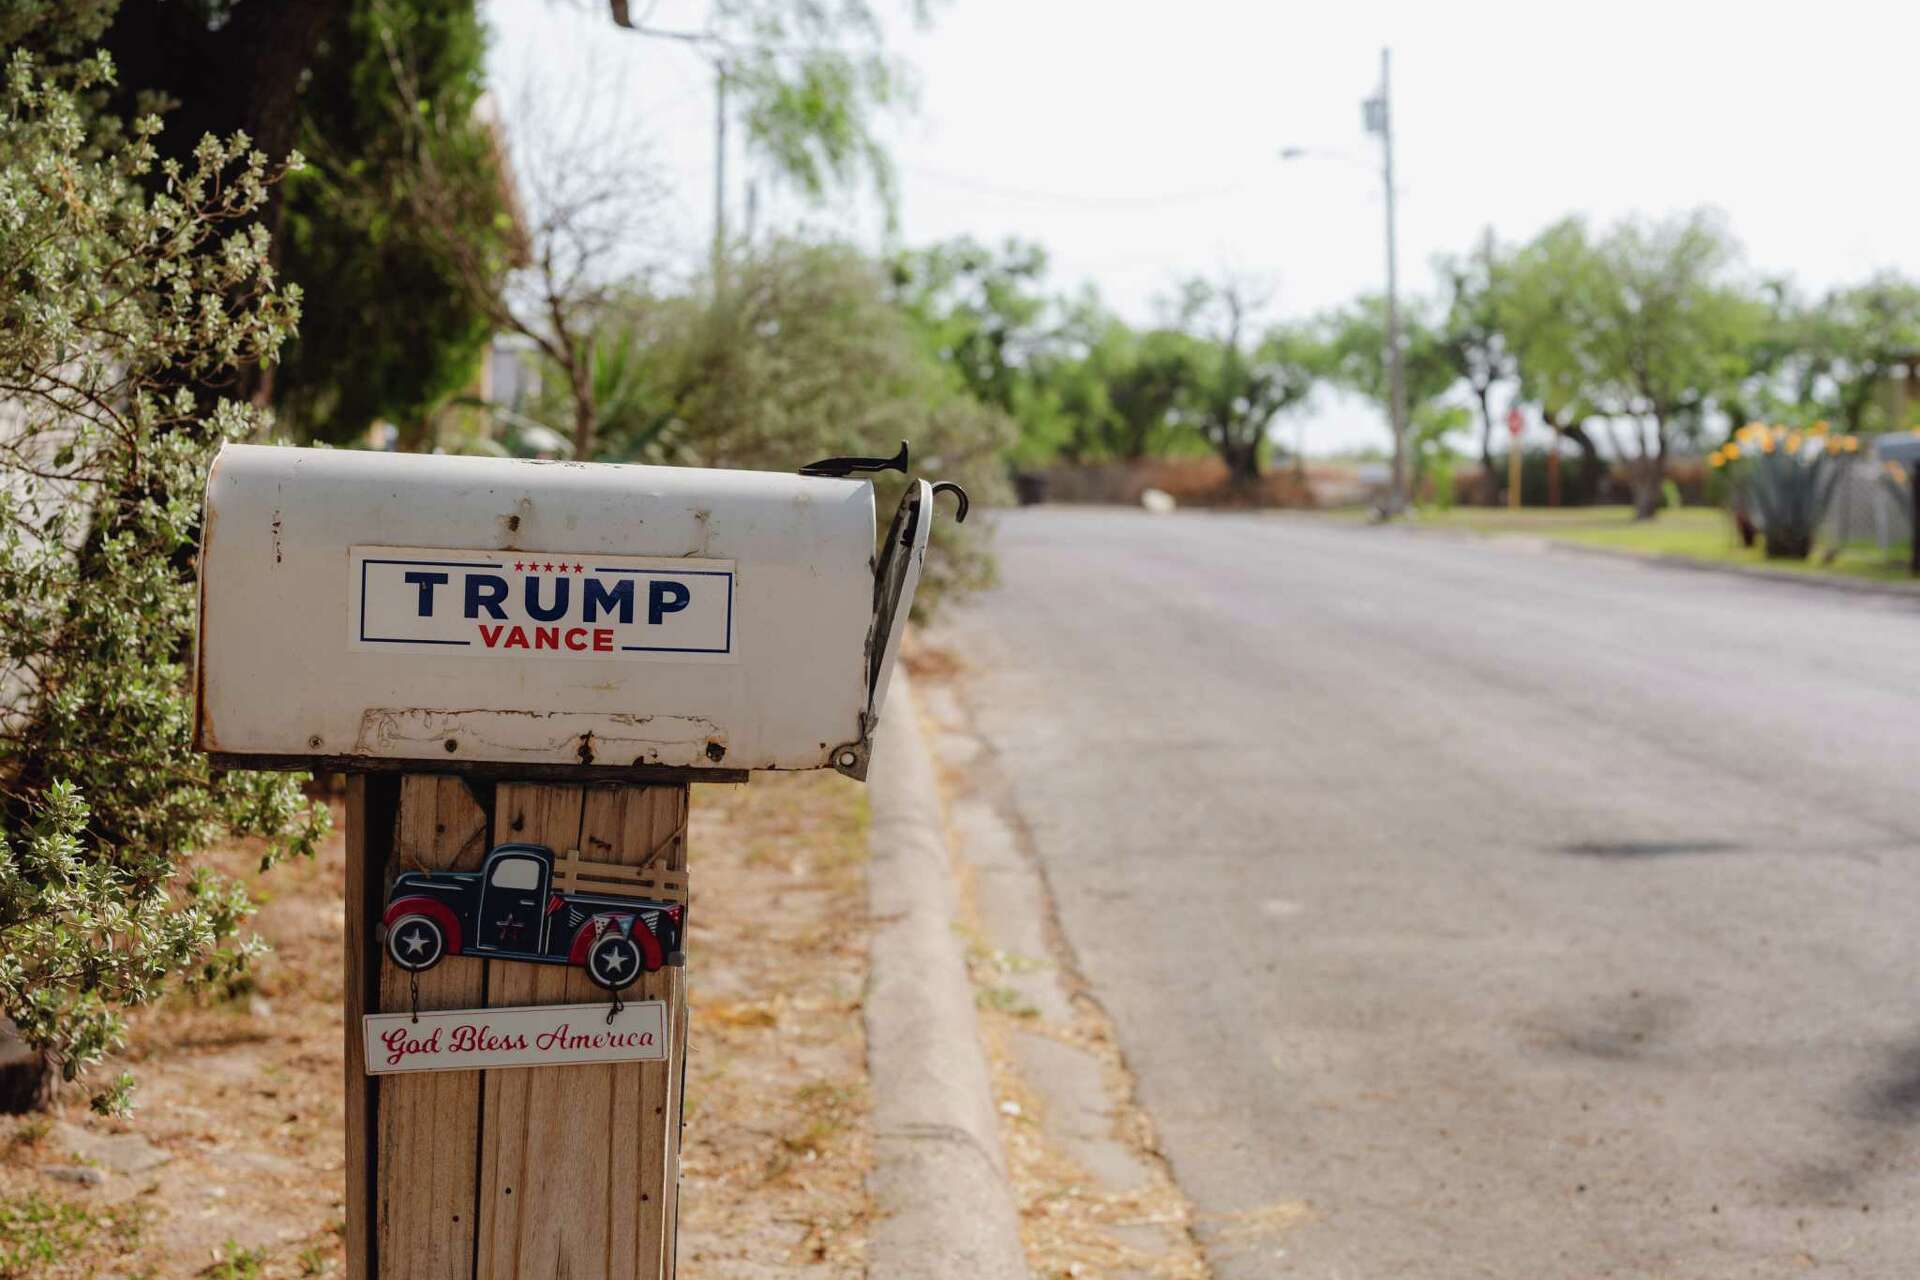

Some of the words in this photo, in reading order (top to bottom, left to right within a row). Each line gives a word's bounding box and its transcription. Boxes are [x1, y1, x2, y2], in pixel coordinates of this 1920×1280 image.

[404, 571, 691, 625] TRUMP
[478, 624, 614, 652] VANCE
[380, 1027, 443, 1065] God
[448, 1024, 529, 1052] Bless
[535, 1023, 654, 1050] America
